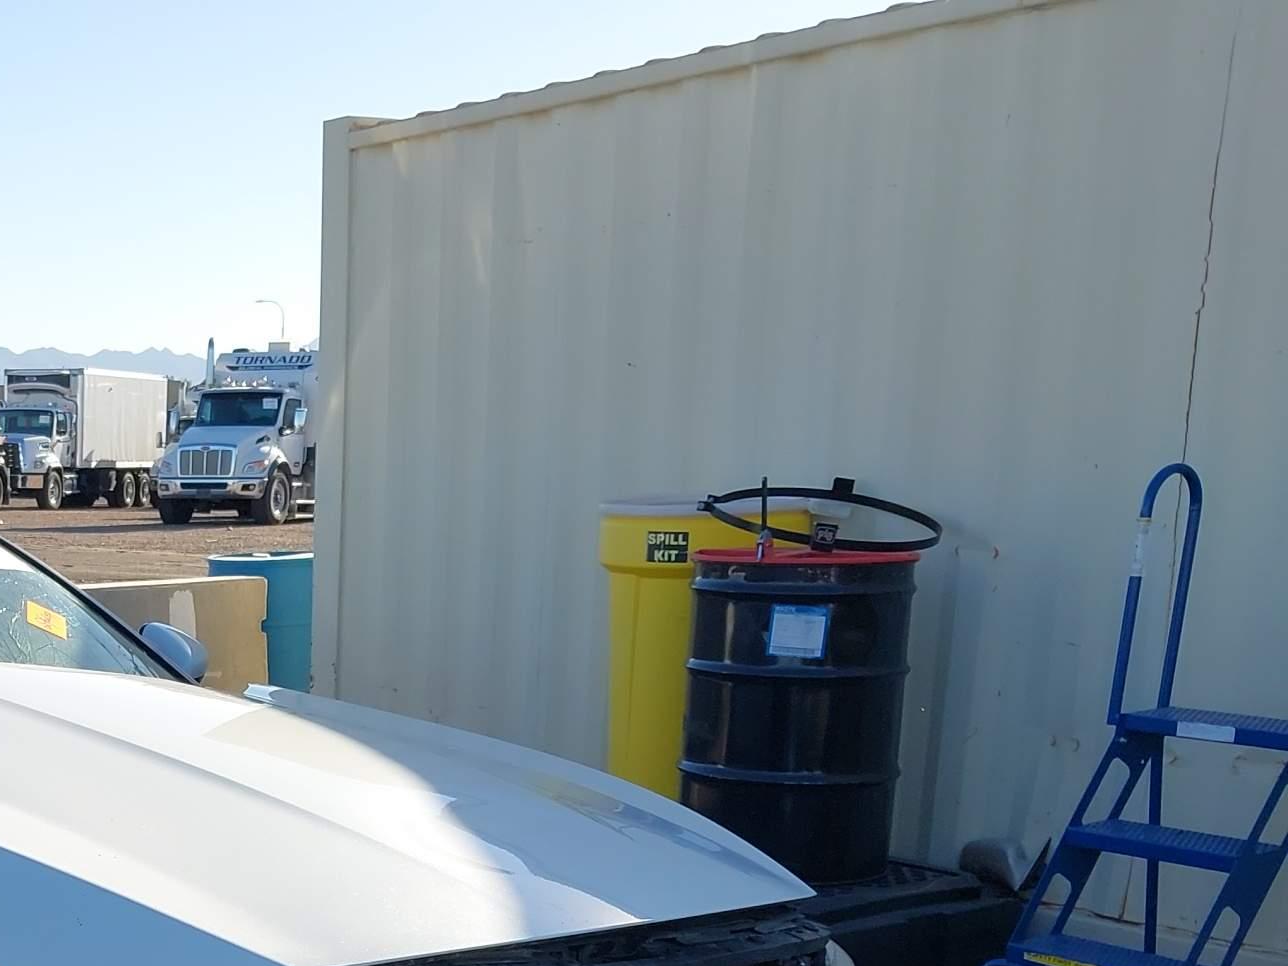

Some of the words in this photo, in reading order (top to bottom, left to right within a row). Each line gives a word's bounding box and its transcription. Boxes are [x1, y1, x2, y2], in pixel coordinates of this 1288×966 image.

[232, 355, 312, 365] TORNADO
[648, 533, 687, 545] SPILL
[654, 550, 679, 562] KIT
